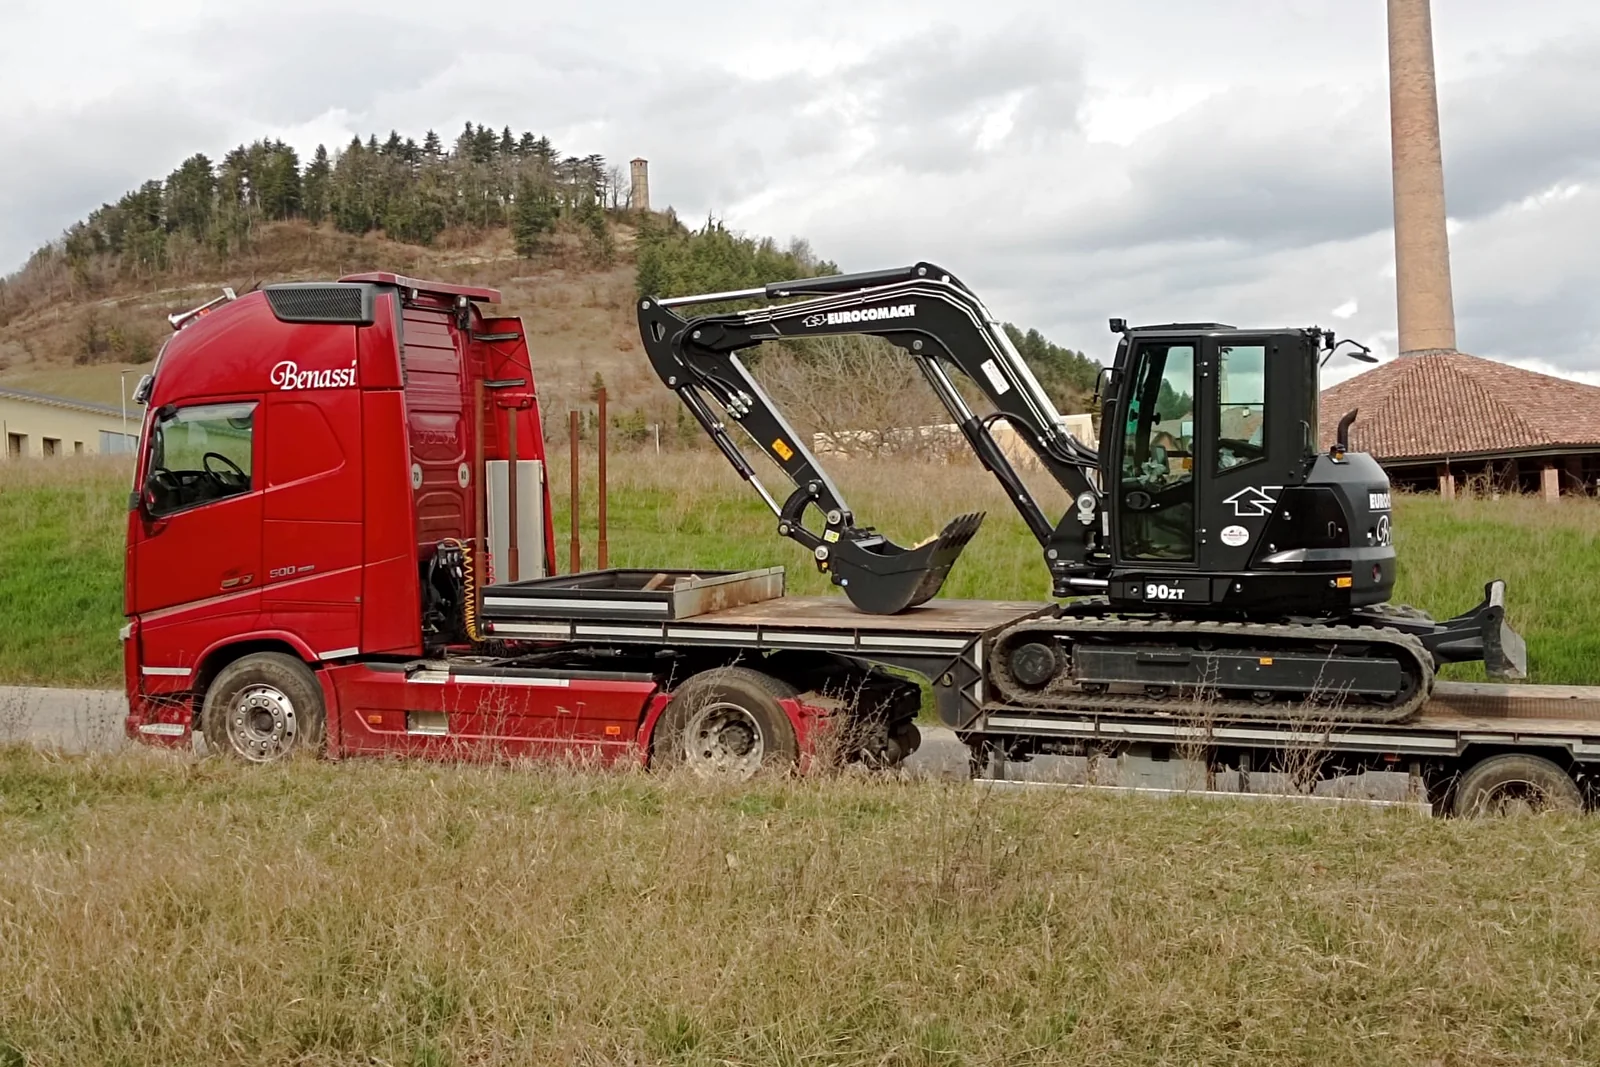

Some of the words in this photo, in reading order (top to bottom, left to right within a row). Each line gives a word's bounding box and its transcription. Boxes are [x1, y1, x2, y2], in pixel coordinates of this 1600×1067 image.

[827, 304, 916, 325] EUROCOMACH
[270, 360, 357, 390] Benassi
[269, 566, 296, 578] 500
